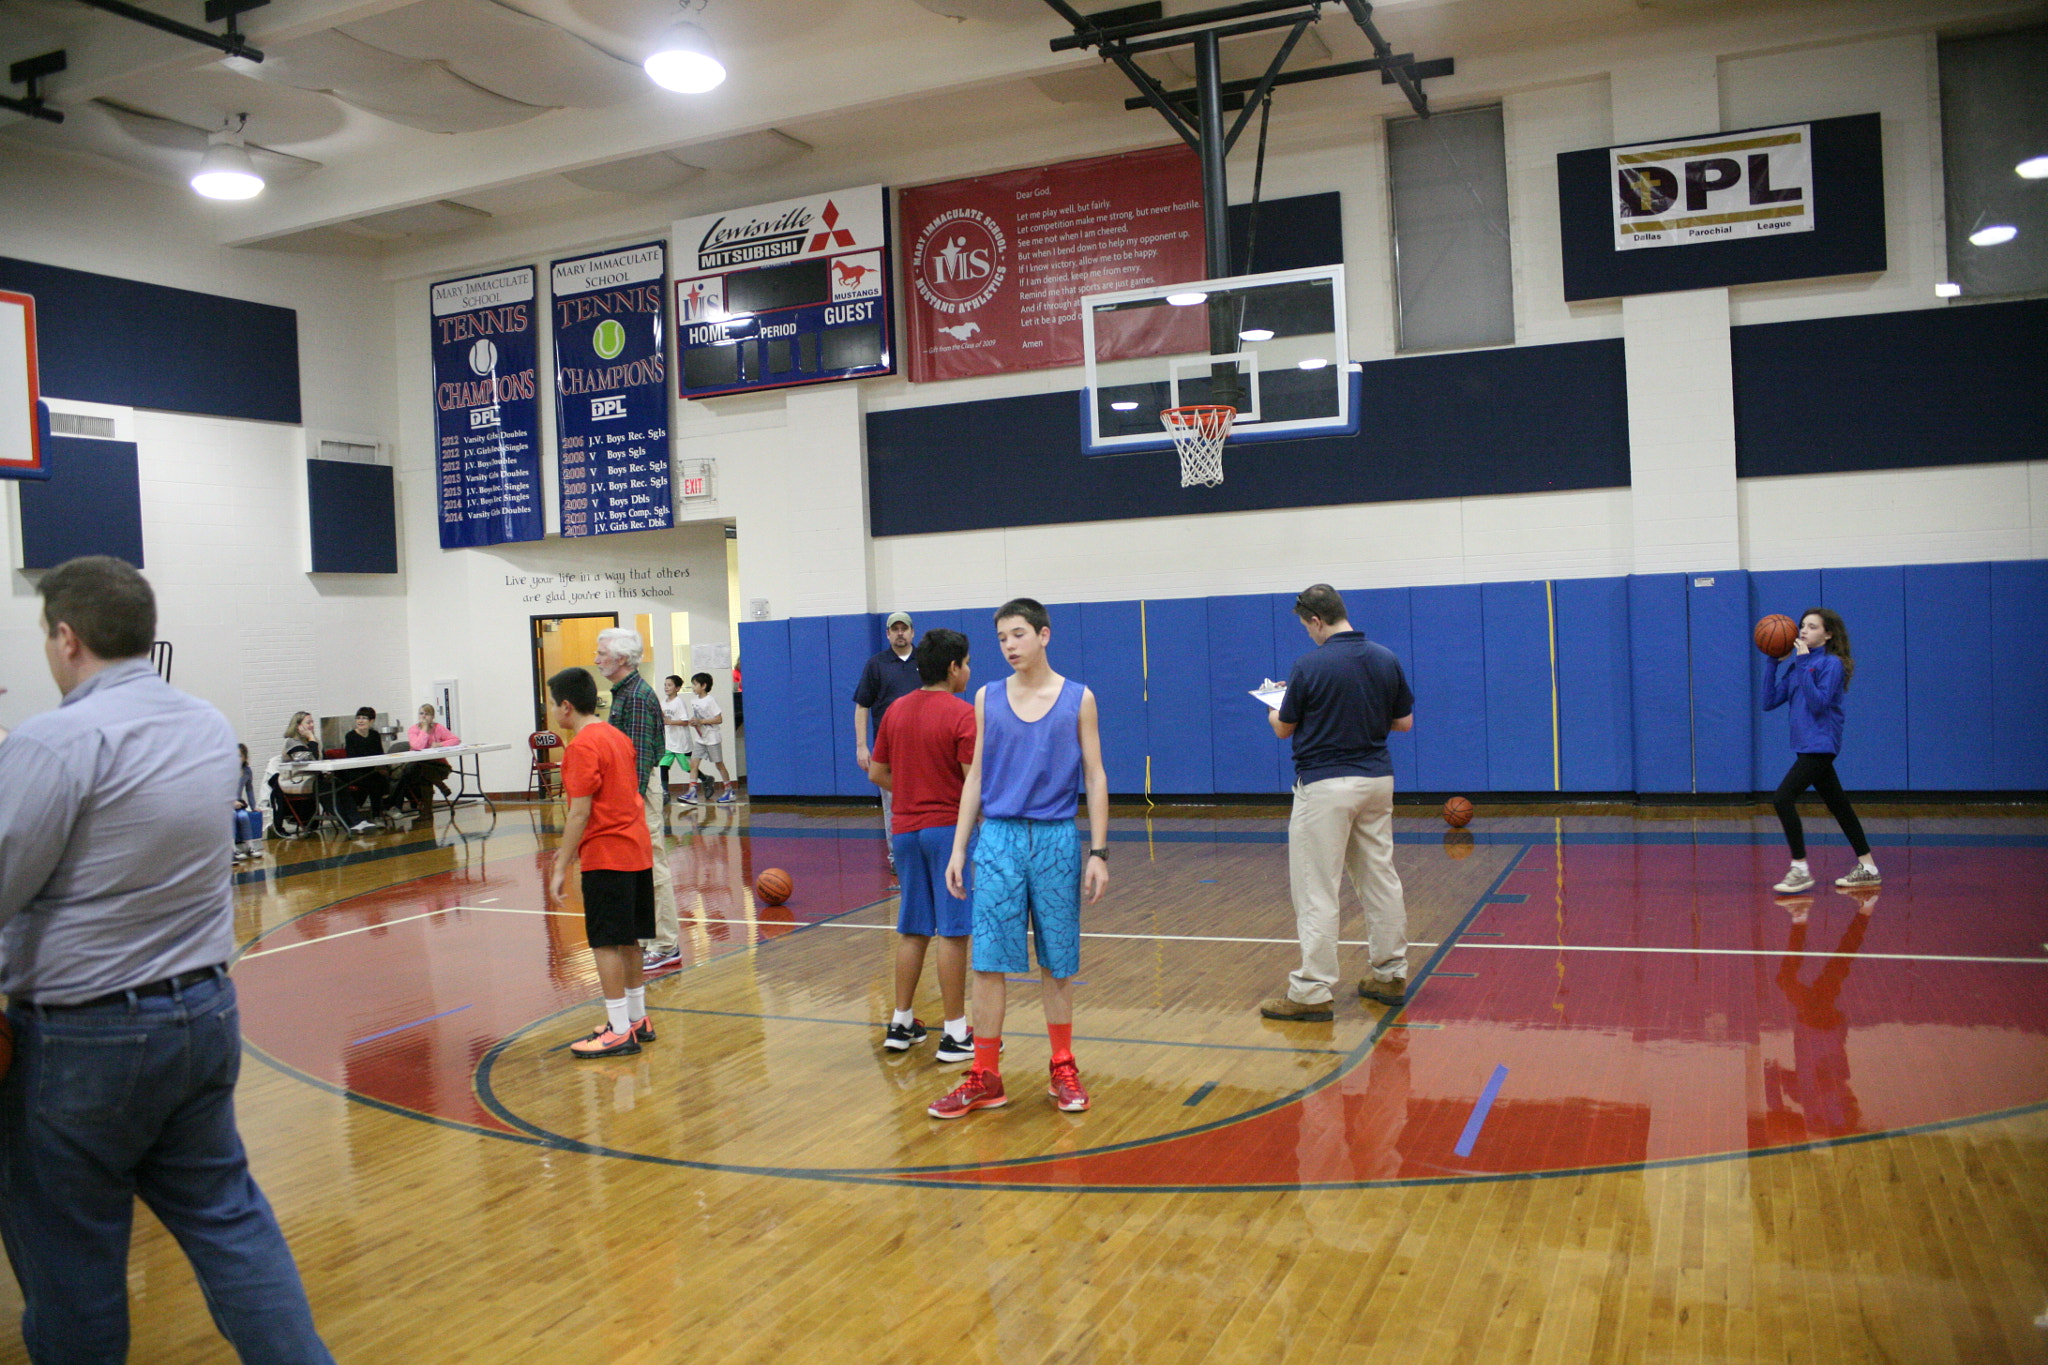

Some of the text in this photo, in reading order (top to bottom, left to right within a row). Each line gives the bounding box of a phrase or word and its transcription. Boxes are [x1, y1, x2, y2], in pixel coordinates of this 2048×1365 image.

[1618, 153, 1802, 218] DPL
[1016, 190, 1032, 200] Dear
[1017, 213, 1028, 221] Let
[1042, 208, 1057, 219] play
[1077, 203, 1089, 212] but
[1017, 226, 1028, 234] Let
[1030, 220, 1074, 232] competition
[1076, 216, 1094, 225] make
[1136, 208, 1148, 217] but
[1150, 205, 1171, 214] never
[698, 207, 815, 252] Lewisville
[913, 208, 1006, 266] MARY IMMACULATE SCHOOL
[1018, 239, 1030, 247] See
[1045, 234, 1058, 243] not
[1059, 232, 1078, 241] when
[1084, 230, 1095, 238] am
[1633, 220, 1792, 242] Dallas Parochial League
[701, 240, 798, 268] MITSUBISHI
[1018, 252, 1030, 260] But
[1032, 249, 1051, 258] when
[1057, 244, 1076, 255] bend
[1077, 243, 1097, 252] down
[1108, 238, 1124, 248] help
[1126, 237, 1138, 246] my
[1140, 232, 1176, 245] opponent
[556, 250, 660, 278] MARY IMMACULATE
[1030, 263, 1049, 272] know
[1079, 256, 1098, 265] allow
[1123, 251, 1132, 259] be
[585, 272, 630, 289] SCHOOL
[1071, 271, 1088, 281] keep
[1090, 270, 1101, 278] me
[1103, 266, 1121, 276] from
[436, 274, 528, 300] MARY IMMACULATE
[834, 288, 879, 301] MUSTANGS
[915, 266, 1006, 314] MUSTANG ATHLETICS
[1020, 289, 1046, 300] Remind
[1062, 286, 1076, 294] that
[1078, 284, 1100, 294] sports
[1115, 279, 1128, 290] just
[462, 292, 502, 308] SCHOOL
[558, 285, 660, 329] TENNIS
[1021, 303, 1035, 314] And
[1037, 301, 1042, 311] if
[1043, 299, 1072, 310] through
[824, 301, 874, 326] GUEST
[1021, 319, 1032, 327] Let
[1041, 315, 1050, 324] be
[1058, 311, 1076, 325] good
[438, 305, 528, 344] TENNIS
[760, 322, 796, 339] PERIOD
[689, 324, 730, 345] HOME
[1022, 340, 1043, 349] Amen
[560, 353, 664, 396] CHAMPIONS
[438, 369, 535, 411] CHAMPIONS
[592, 400, 627, 416] DPL
[470, 410, 501, 426] DPL
[589, 436, 603, 447] J.V.
[607, 434, 626, 444] Boys
[628, 432, 645, 440] Rec.
[648, 428, 666, 440] Sgls
[589, 452, 596, 461] V
[607, 450, 626, 460] Boys
[628, 446, 646, 459] Sgls
[590, 468, 597, 476] V
[608, 466, 627, 476] Boys
[629, 464, 646, 472] Rec.
[649, 460, 667, 472] Sgls
[590, 476, 668, 494] J.V. Boys Rec. Sgls
[684, 478, 702, 495] EXIT
[592, 499, 599, 508] V
[610, 497, 628, 508] Boys
[631, 494, 650, 504] Dbls
[594, 505, 670, 522] J.V. Boys Comp. Sgls.
[595, 518, 667, 534] J.V. Girls Rec. Dbls.
[505, 575, 526, 586] Live
[530, 576, 553, 589] your
[558, 572, 575, 587] life
[580, 572, 590, 582] in
[604, 571, 626, 584] way
[629, 568, 651, 579] that
[656, 566, 690, 579] others
[522, 594, 541, 602] are
[546, 590, 566, 603] glad
[568, 591, 600, 605] you're
[605, 589, 615, 598] in
[619, 587, 637, 598] this
[534, 734, 556, 746] MIS
